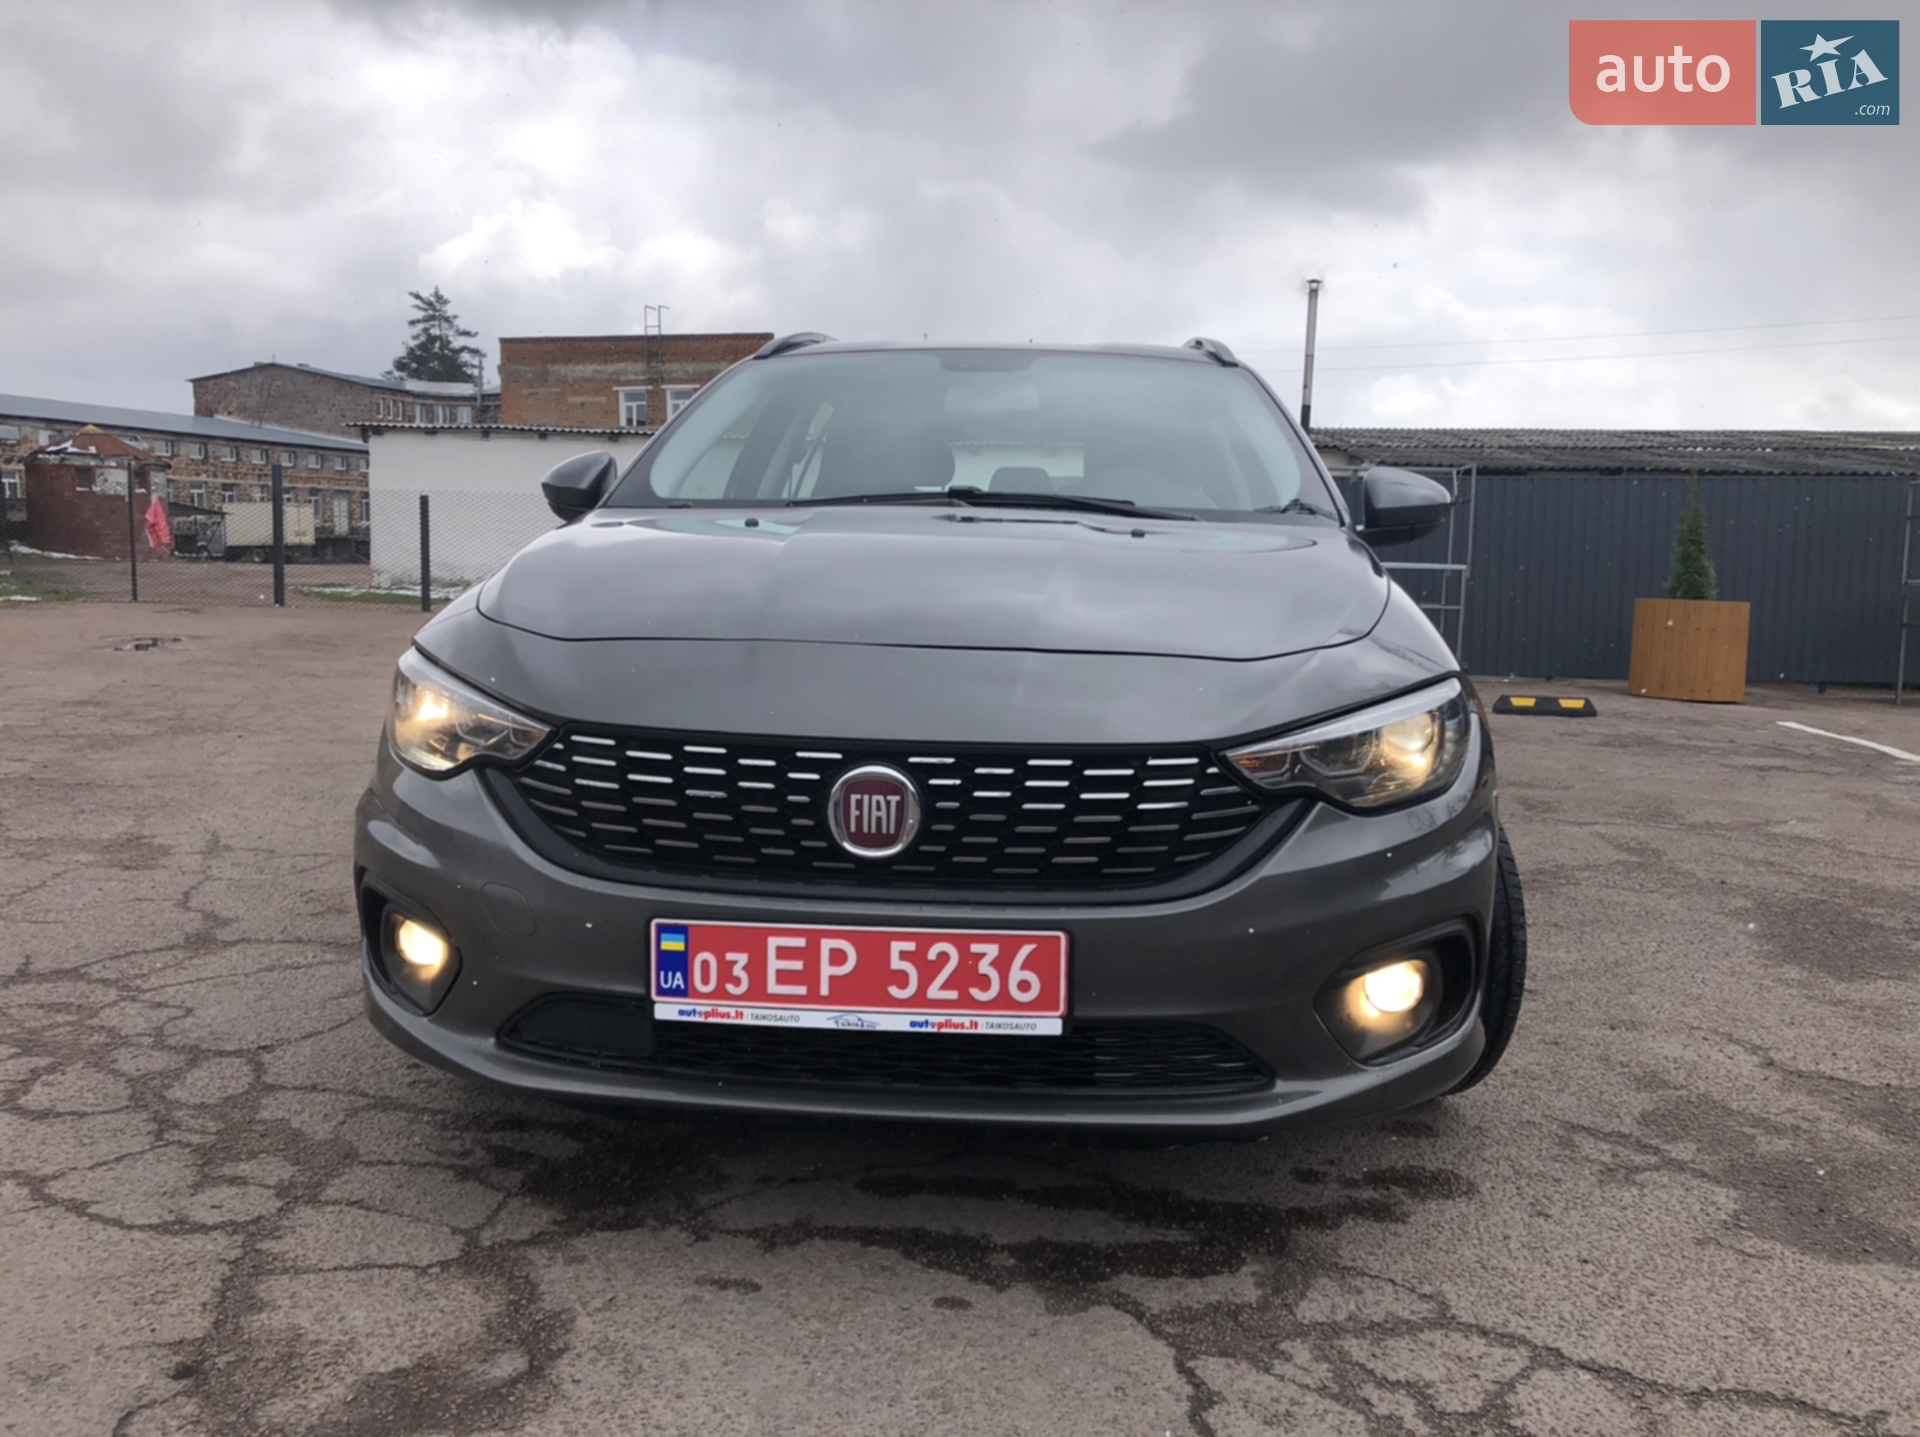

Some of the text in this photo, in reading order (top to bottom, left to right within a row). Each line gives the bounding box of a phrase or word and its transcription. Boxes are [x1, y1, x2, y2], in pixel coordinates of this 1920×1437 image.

[849, 793, 901, 835] FIAT
[692, 936, 1042, 1003] 03 EP 5236
[659, 970, 686, 990] UA
[678, 1007, 745, 1021] autoplius.lt
[909, 1017, 979, 1032] autoplius.lt
